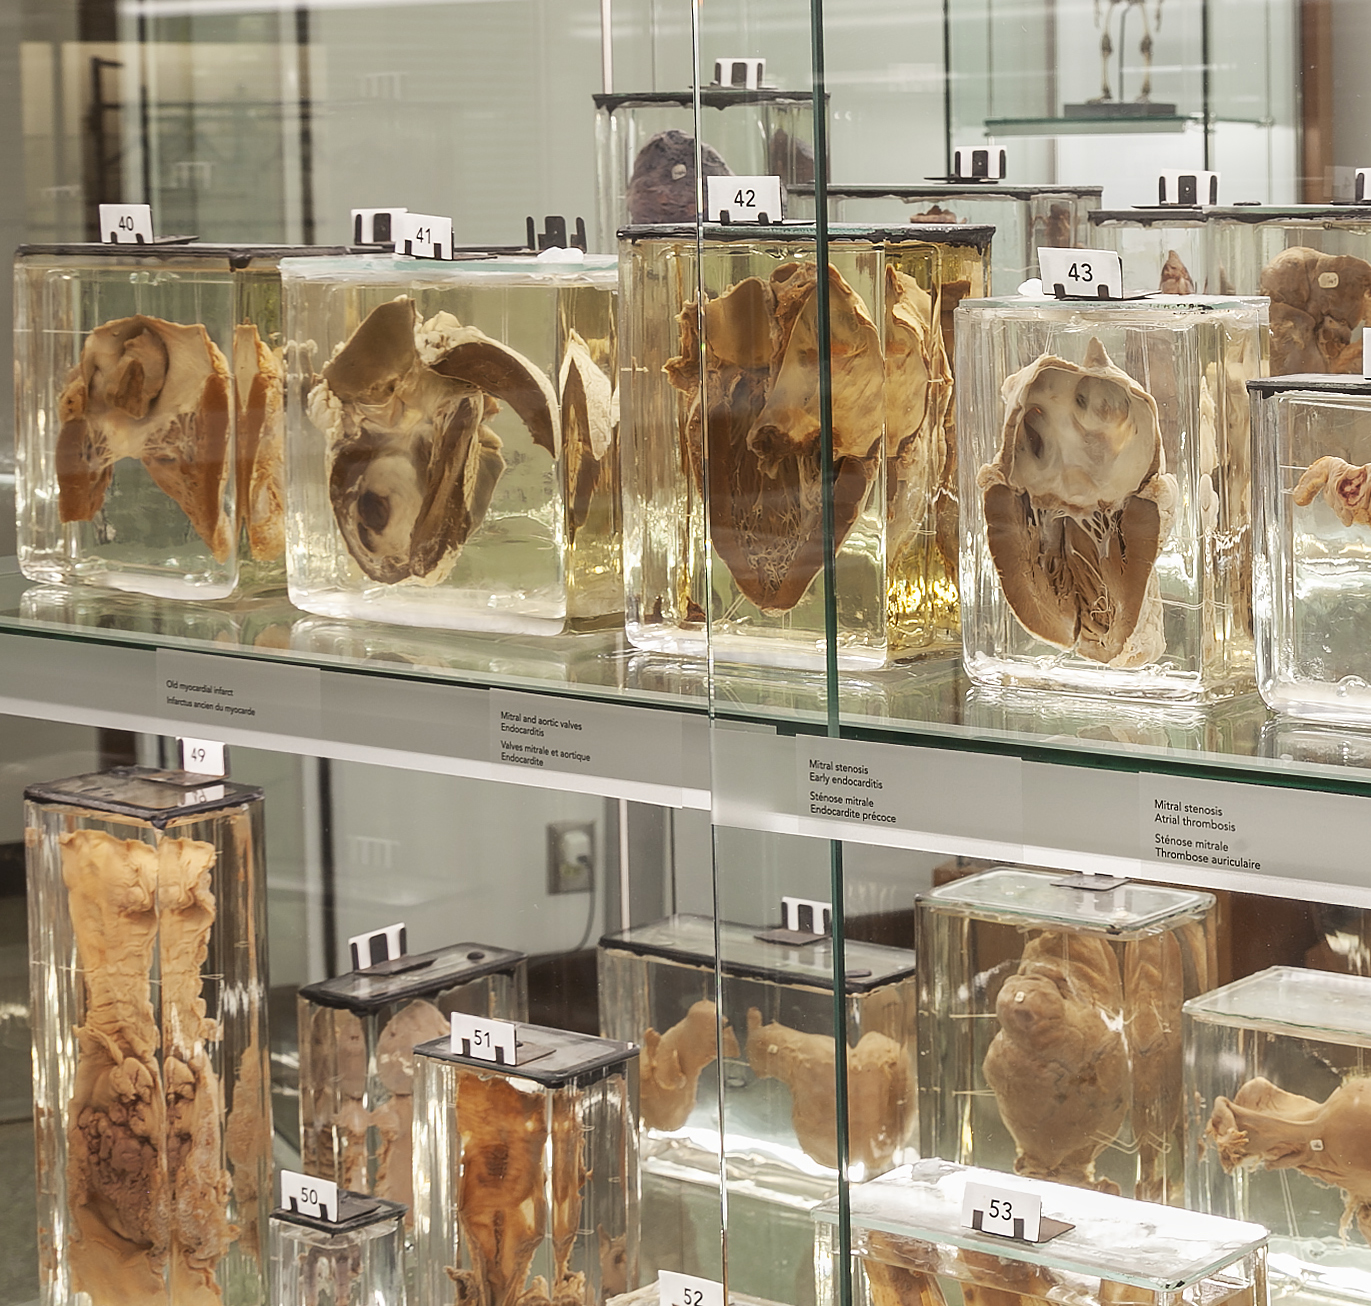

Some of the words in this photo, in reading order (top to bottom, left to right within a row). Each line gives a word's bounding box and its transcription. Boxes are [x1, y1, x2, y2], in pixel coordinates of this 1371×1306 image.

[734, 189, 756, 207] 42
[118, 216, 134, 231] 40
[416, 227, 431, 243] 41
[1067, 262, 1093, 283] 43
[501, 711, 521, 722] Mitral
[523, 715, 537, 724] and
[538, 718, 559, 727] aortic
[560, 720, 582, 730] valves
[501, 722, 544, 737] Endocarditis
[191, 748, 206, 762] 49
[500, 740, 523, 751] Valves
[524, 745, 549, 755] mitrale
[560, 751, 590, 762] aortique
[501, 752, 543, 766] Endocardite
[809, 759, 833, 770] Mitral
[835, 764, 868, 774] stenosis
[809, 772, 830, 785] Early
[832, 775, 883, 789] endocarditis
[810, 791, 843, 804] Sténose
[845, 796, 874, 807] mitrale
[1155, 799, 1181, 811] Mitral
[1184, 805, 1223, 816] stenosis
[810, 804, 860, 818] Endocardite
[862, 811, 896, 823] précoce
[1154, 813, 1180, 825] Atrial
[1182, 816, 1235, 832] thrombosis
[1155, 833, 1192, 847] Sténose
[1195, 839, 1228, 852] mitrale
[1155, 847, 1208, 863] Thrombose
[1211, 856, 1261, 870] auriculaire
[474, 1029, 490, 1048] 51
[301, 1187, 318, 1205] 50
[988, 1199, 1012, 1221] 53
[684, 1287, 703, 1306] 52
